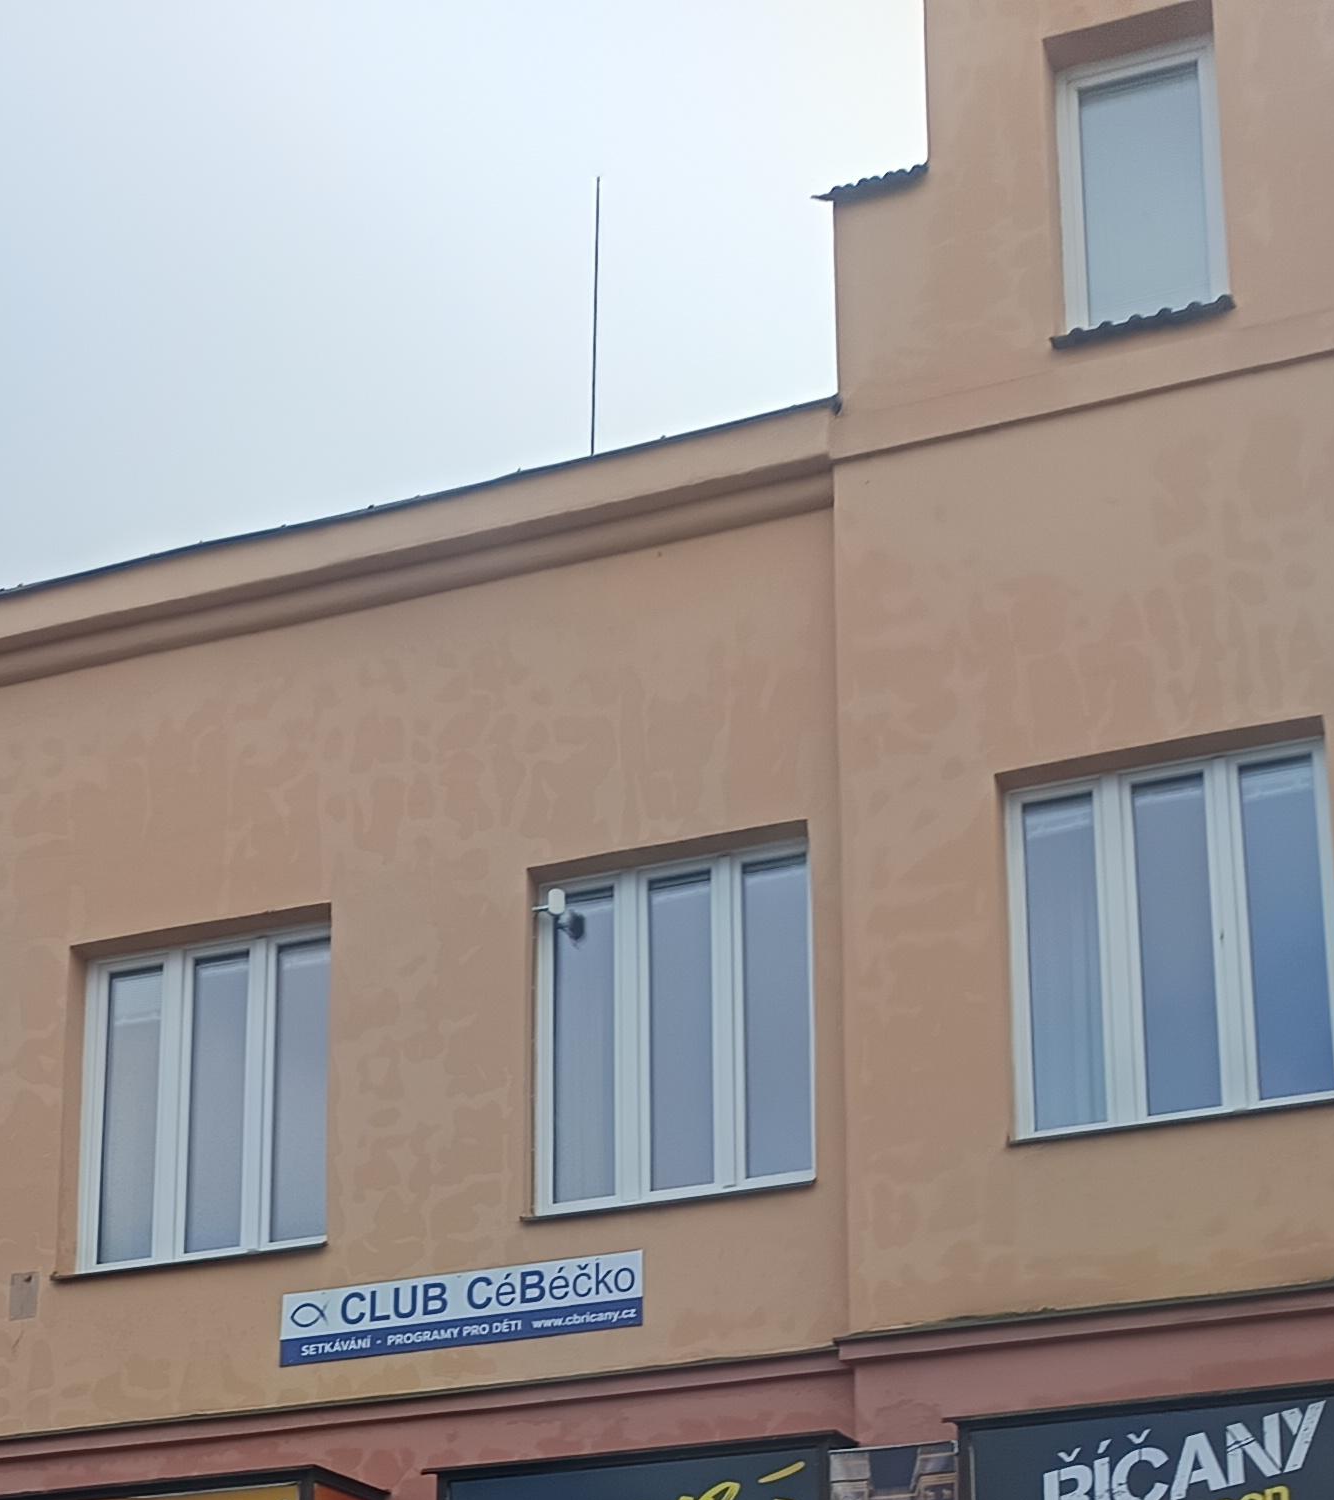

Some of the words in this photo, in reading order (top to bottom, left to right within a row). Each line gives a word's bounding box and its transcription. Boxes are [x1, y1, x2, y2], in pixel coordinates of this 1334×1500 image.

[341, 1282, 448, 1325] CLUB
[467, 1262, 635, 1311] CéBéčko
[300, 1337, 371, 1357] SETKÁVÁNÍ
[387, 1326, 460, 1346] PROGRAMY
[462, 1322, 489, 1337] PRO
[531, 1308, 637, 1330] www.cbricany.cz
